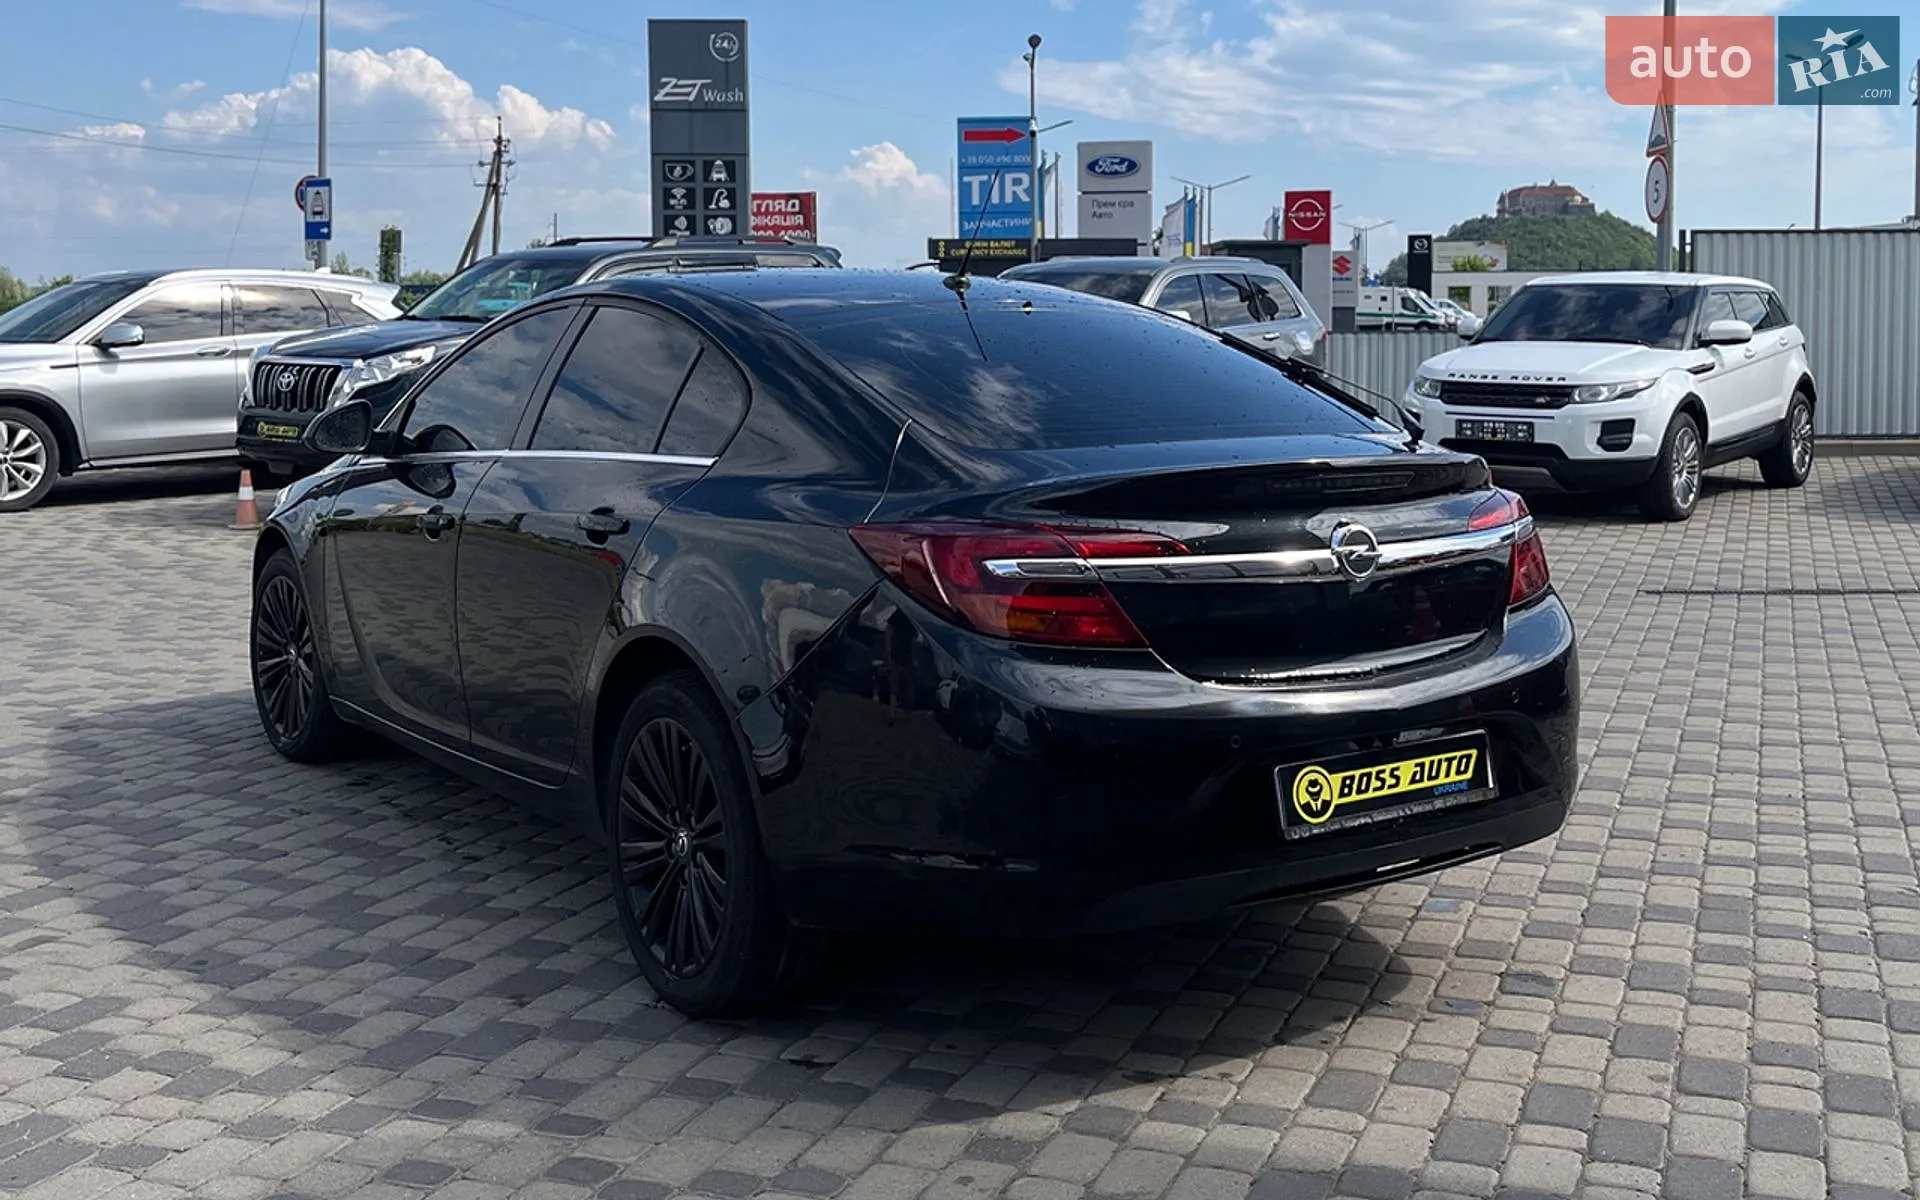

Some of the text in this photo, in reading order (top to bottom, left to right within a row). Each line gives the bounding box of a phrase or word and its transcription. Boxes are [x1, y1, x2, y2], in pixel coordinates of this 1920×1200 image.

[654, 78, 744, 102] ZET Wash
[1095, 158, 1129, 173] Ford
[962, 172, 1031, 206] TIR
[1448, 372, 1567, 383] RANGE ROVER
[1338, 753, 1473, 798] BOSS AUTO
